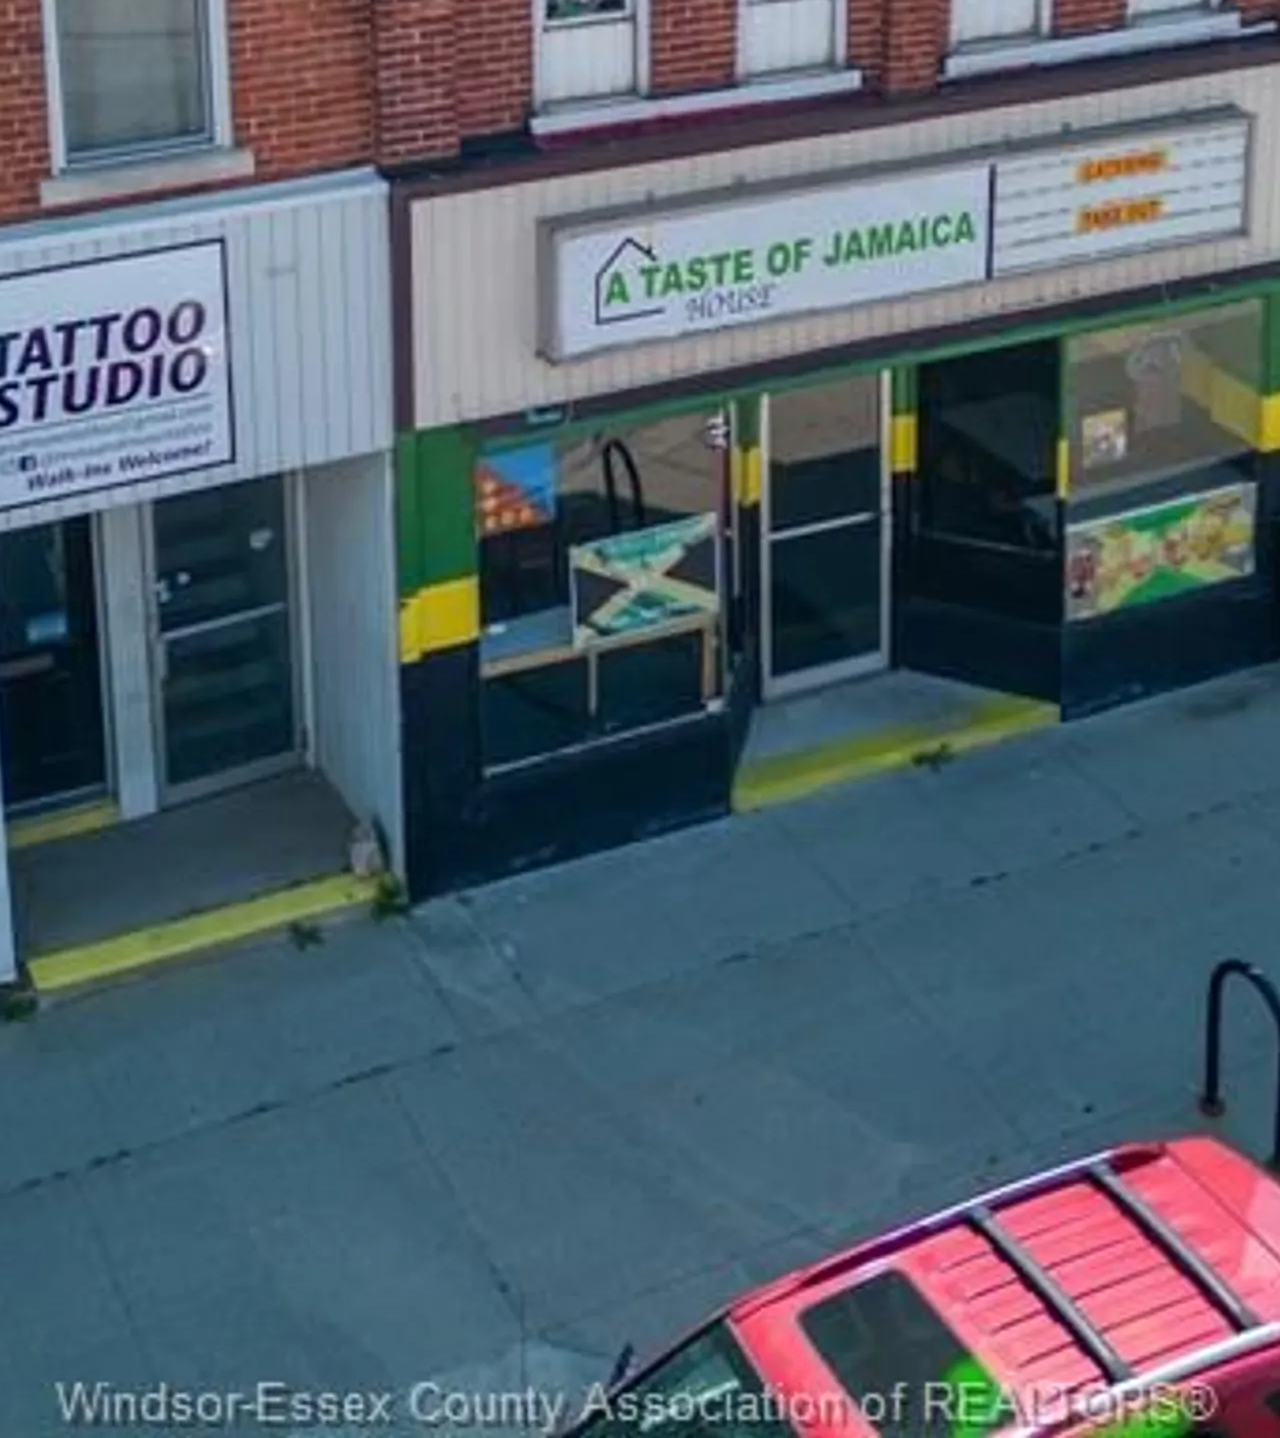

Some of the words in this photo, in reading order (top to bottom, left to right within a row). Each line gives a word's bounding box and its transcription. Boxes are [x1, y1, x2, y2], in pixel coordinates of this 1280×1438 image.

[605, 270, 629, 306] A
[638, 249, 753, 299] TASTE
[768, 239, 812, 276] OF
[823, 212, 976, 265] JAMAICA
